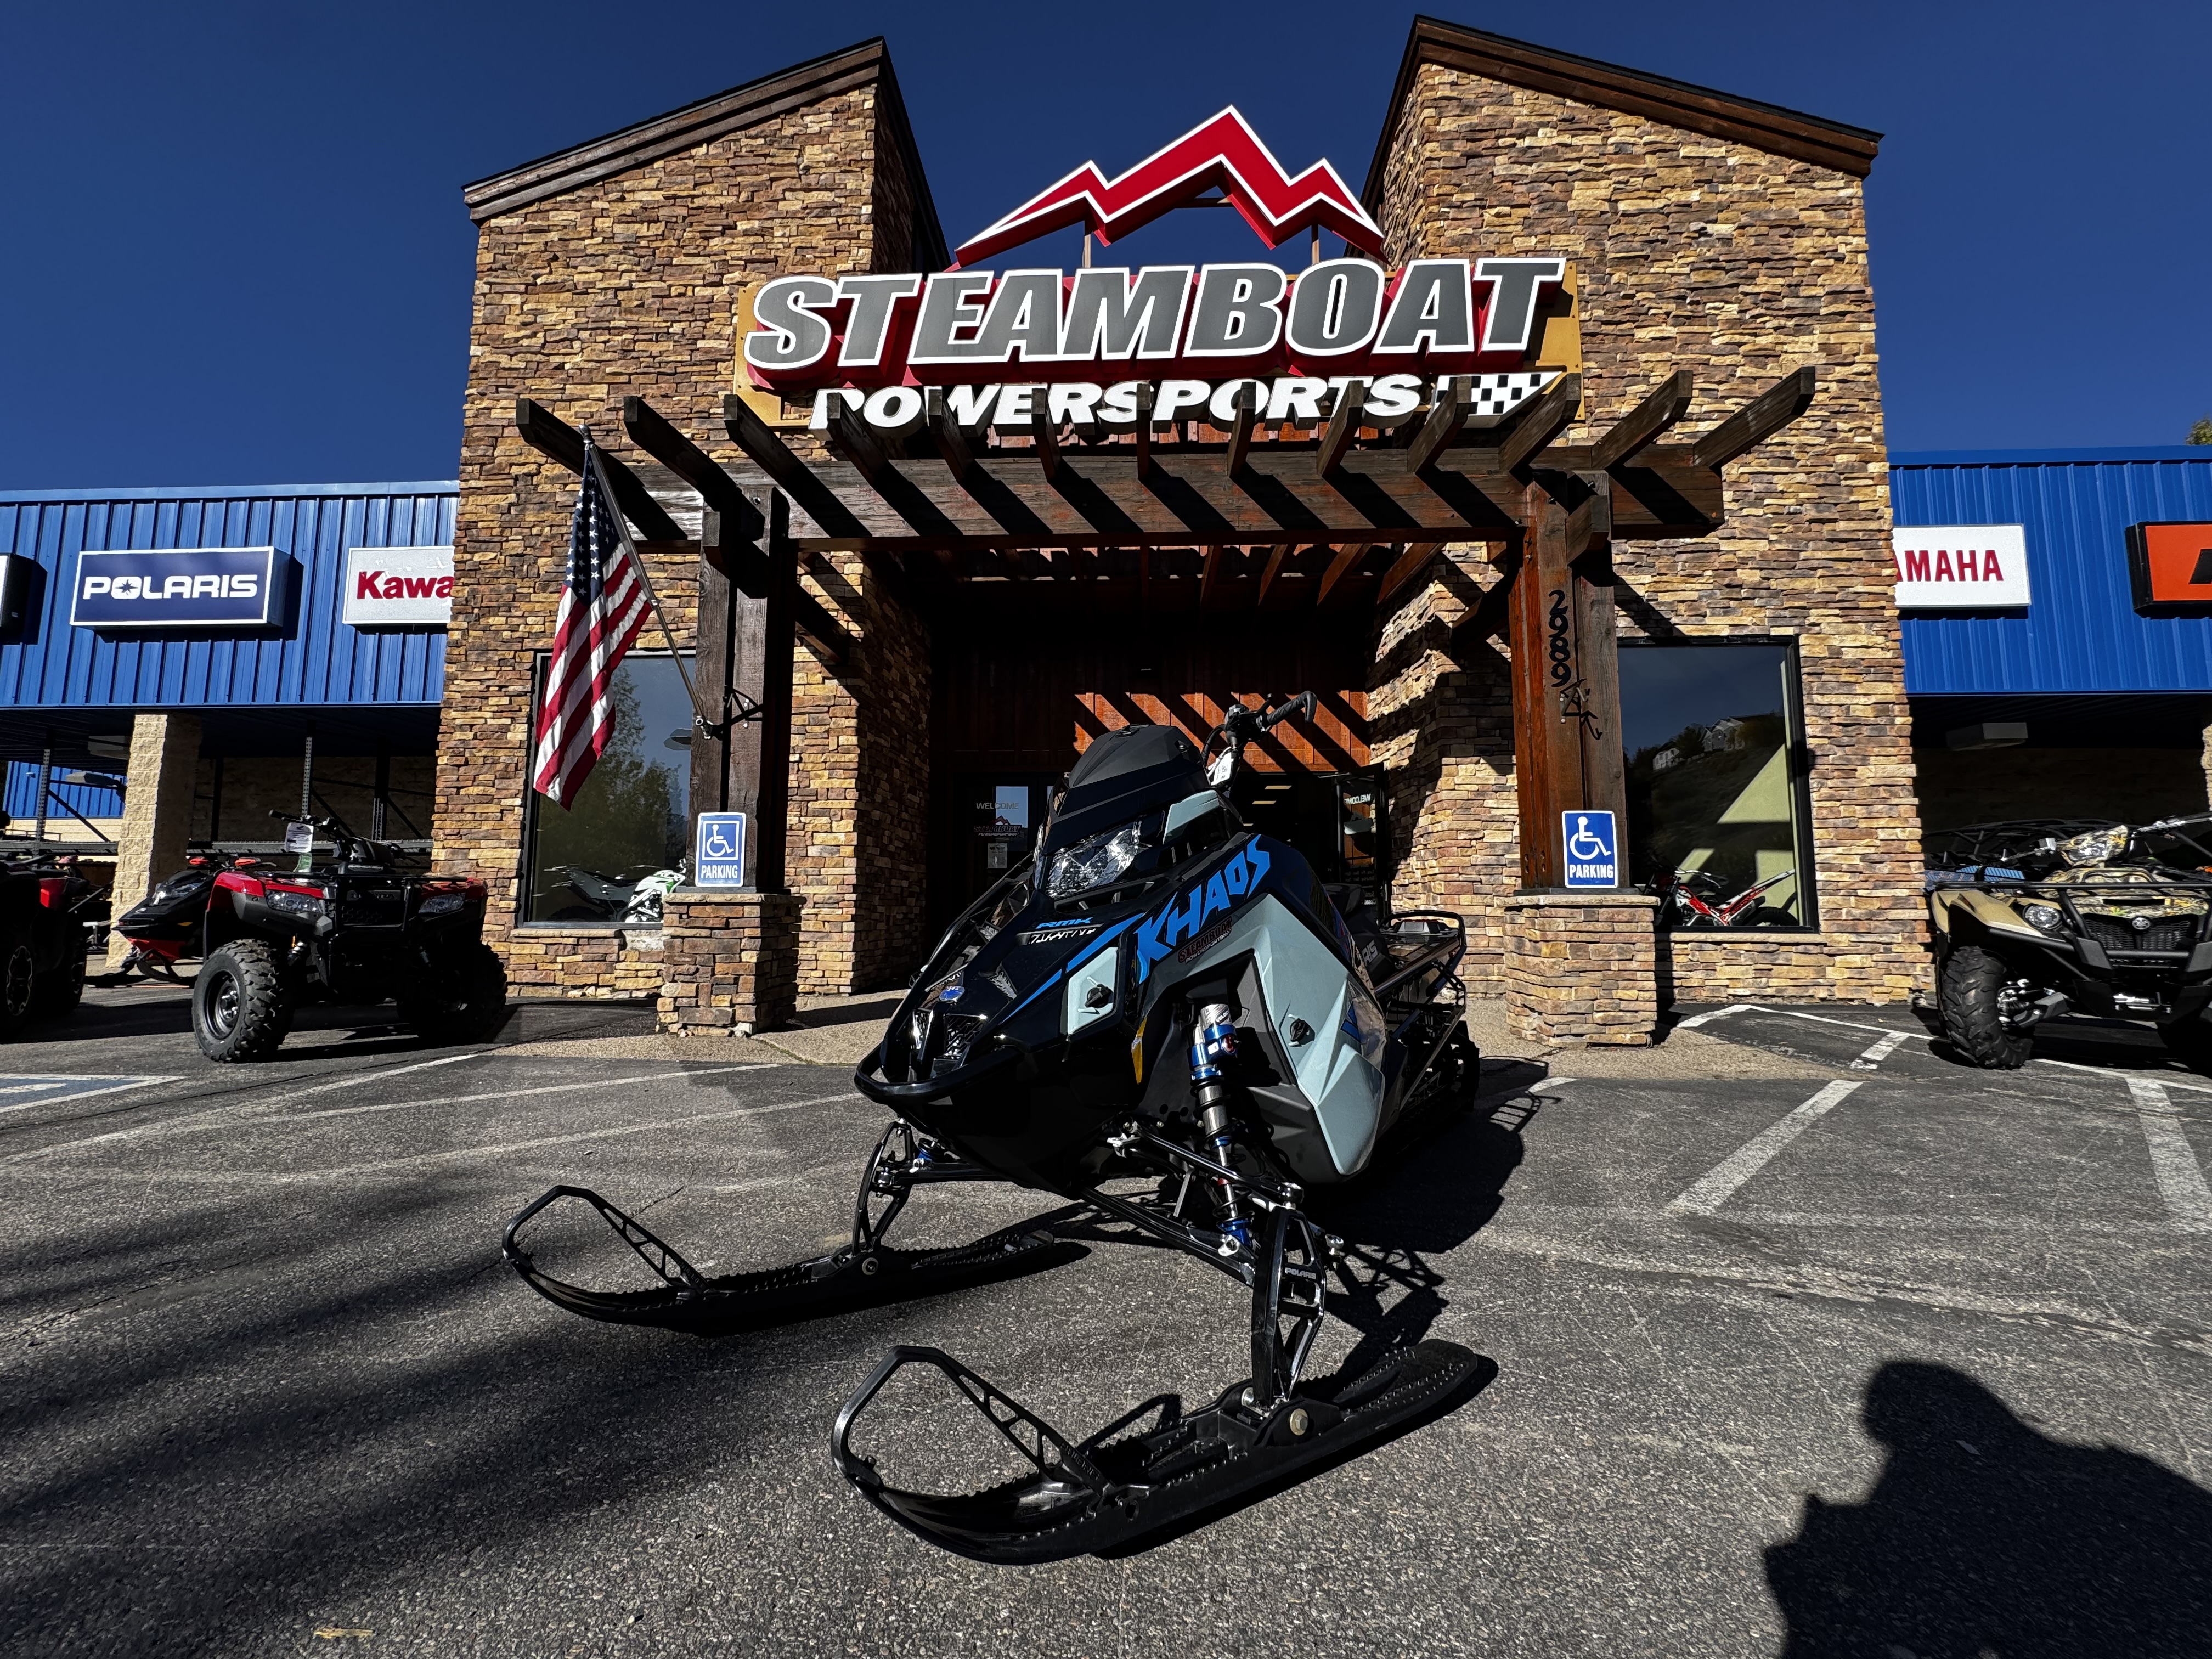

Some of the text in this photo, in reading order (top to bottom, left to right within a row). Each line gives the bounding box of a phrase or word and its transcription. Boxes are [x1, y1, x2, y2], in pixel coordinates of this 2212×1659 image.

[743, 257, 1567, 371] STEAMBOAT
[808, 373, 1423, 431] POWERSPORTS
[83, 573, 258, 600] POLARIS
[357, 569, 455, 600] Kawa
[701, 865, 738, 879] PARKING
[1569, 864, 1614, 879] PARKING
[1035, 917, 1093, 929] RMK
[1133, 833, 1271, 985] KHAOS
[1179, 918, 1232, 963] STEAMBOAT
[1285, 1267, 1317, 1280] POLARIS
